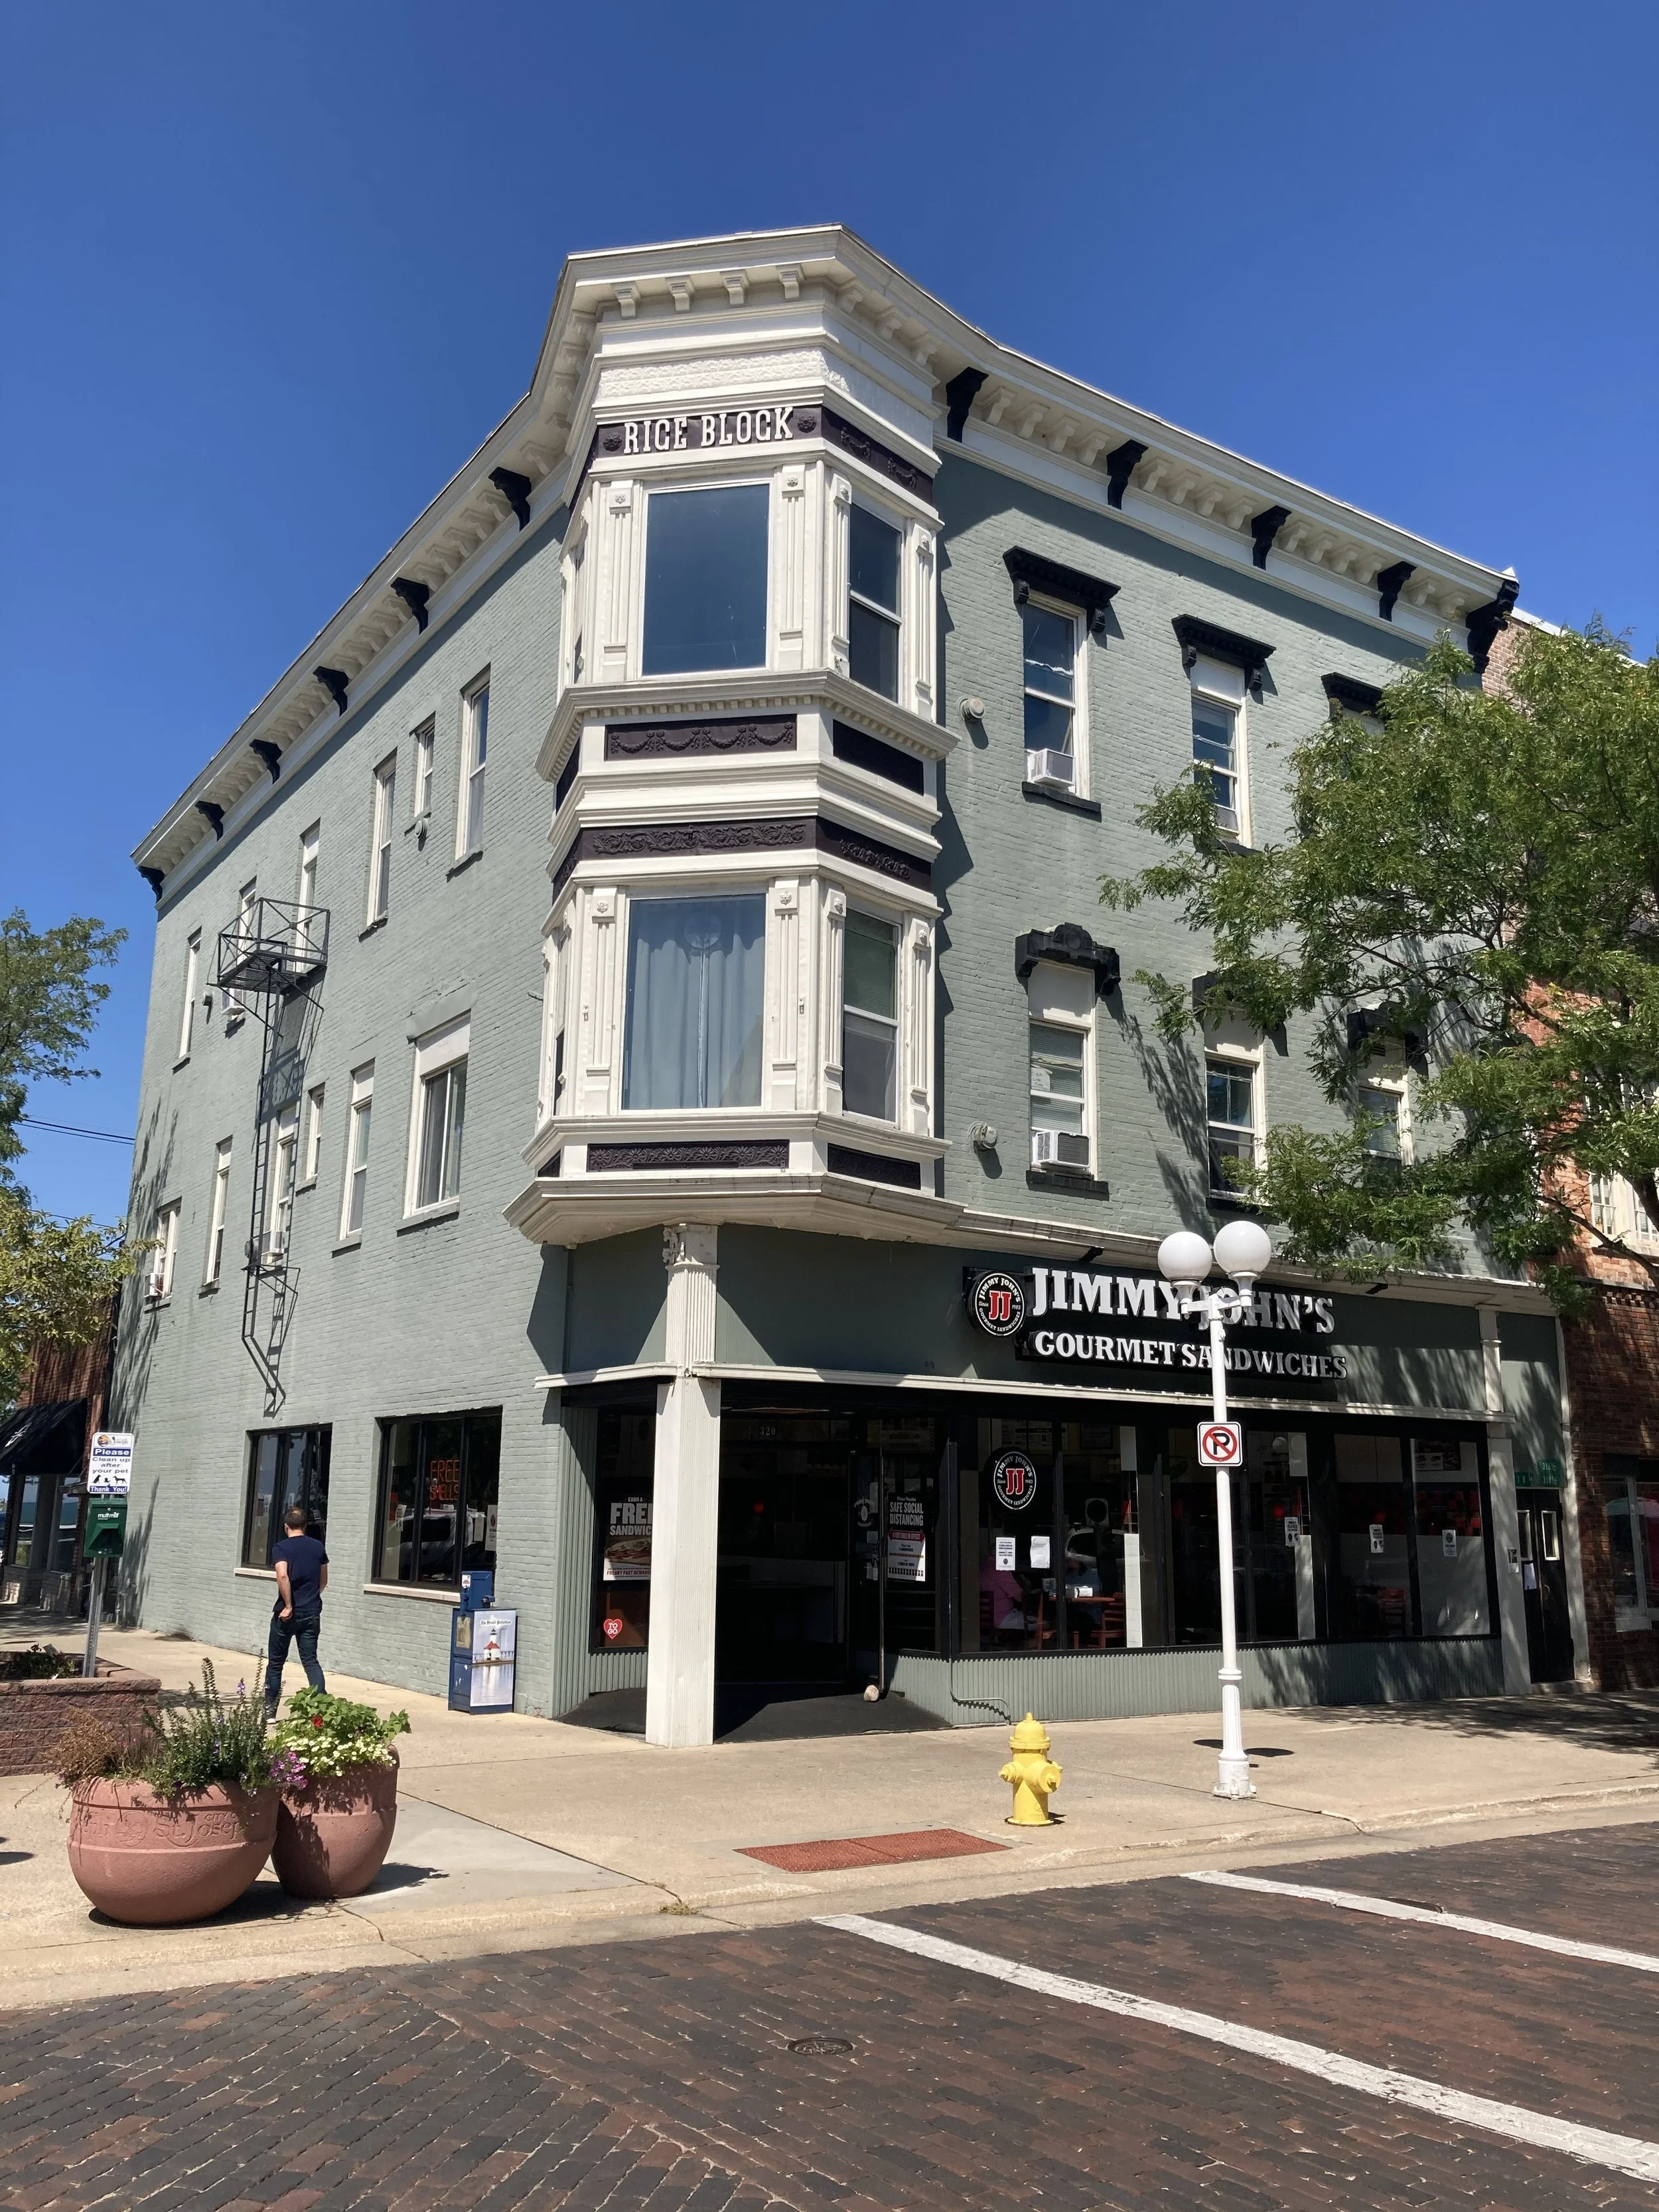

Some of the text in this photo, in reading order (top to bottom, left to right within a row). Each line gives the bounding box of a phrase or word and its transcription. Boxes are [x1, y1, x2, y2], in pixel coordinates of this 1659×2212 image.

[624, 407, 794, 454] RICE BLOCK
[979, 1277, 1021, 1302] JIMMY JOHN'S
[1032, 1267, 1181, 1320] JIMMY
[989, 1290, 1011, 1321] JJ
[979, 1307, 1021, 1332] GOURMET SANDWICHES
[1035, 1331, 1175, 1365] GOURMET
[760, 1427, 776, 1436] 320
[1212, 1433, 1230, 1455] P
[431, 1460, 460, 1483] FREE
[997, 1455, 1033, 1478] JIMMY JOHN'S
[429, 1484, 459, 1501] SMELLS
[1006, 1468, 1025, 1495] JJ
[890, 1501, 924, 1514] SAFE SOCIAL
[610, 1525, 652, 1536] SANDWIC
[889, 1514, 924, 1526] DISTANCING
[205, 1812, 229, 1821] CITY
[185, 1814, 240, 1844] Jose
